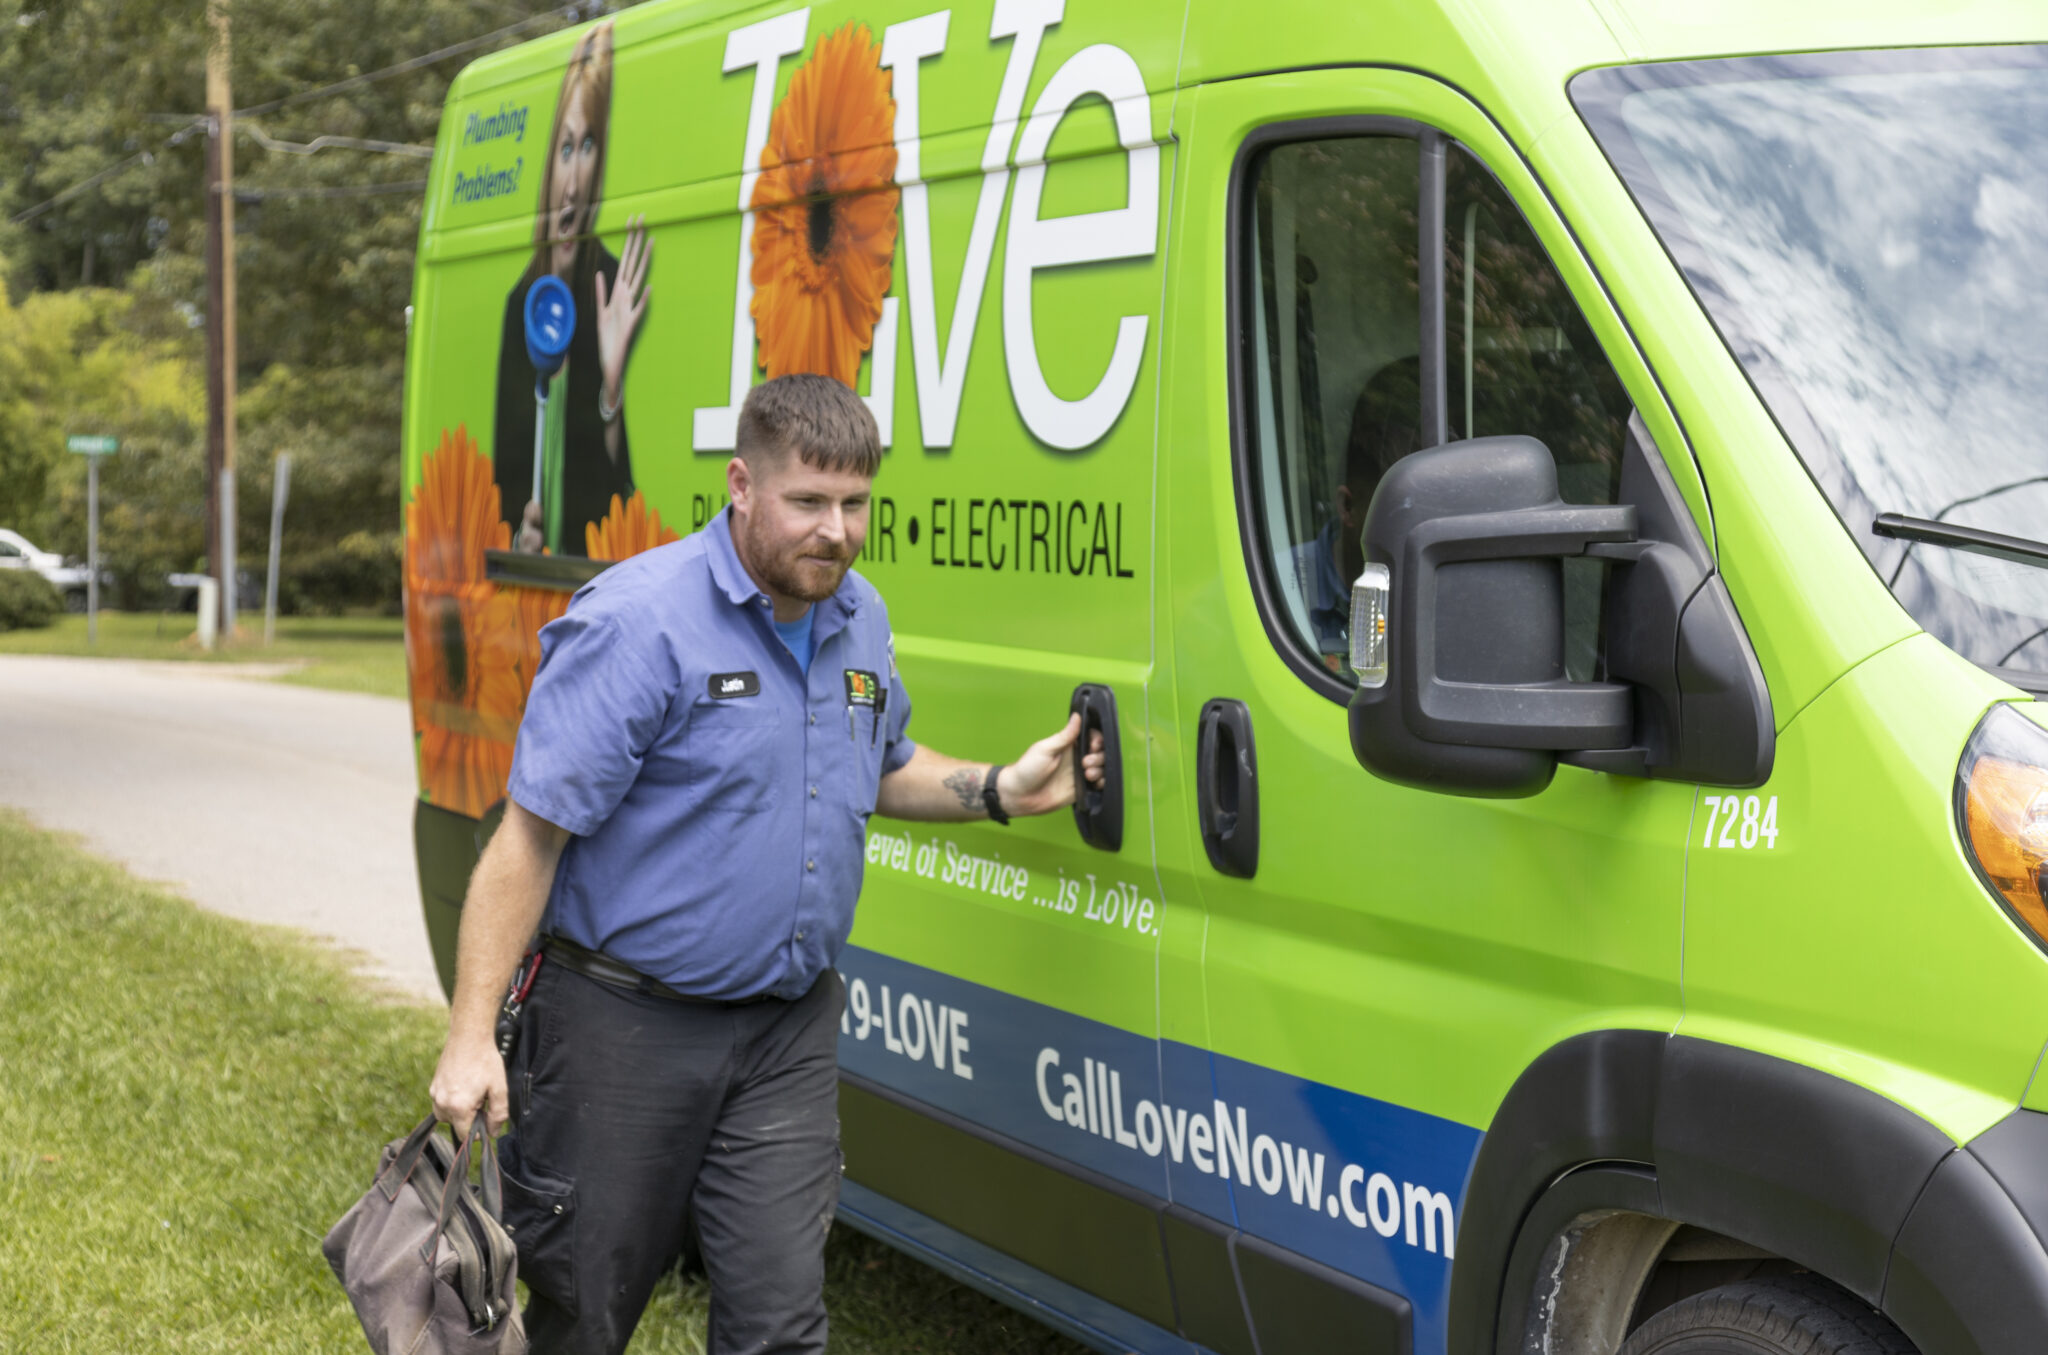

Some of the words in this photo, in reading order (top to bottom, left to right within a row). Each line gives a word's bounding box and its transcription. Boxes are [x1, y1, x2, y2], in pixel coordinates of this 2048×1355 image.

[463, 101, 529, 148] Plumbing
[452, 156, 523, 205] Problems?
[862, 496, 897, 563] IR
[931, 497, 1135, 578] ELECTRICAL
[1703, 794, 1779, 849] 7284
[865, 830, 912, 872] evel
[915, 837, 939, 878] of
[942, 840, 1029, 901] Service
[1035, 1046, 1455, 1260] CallLoveNow.com
